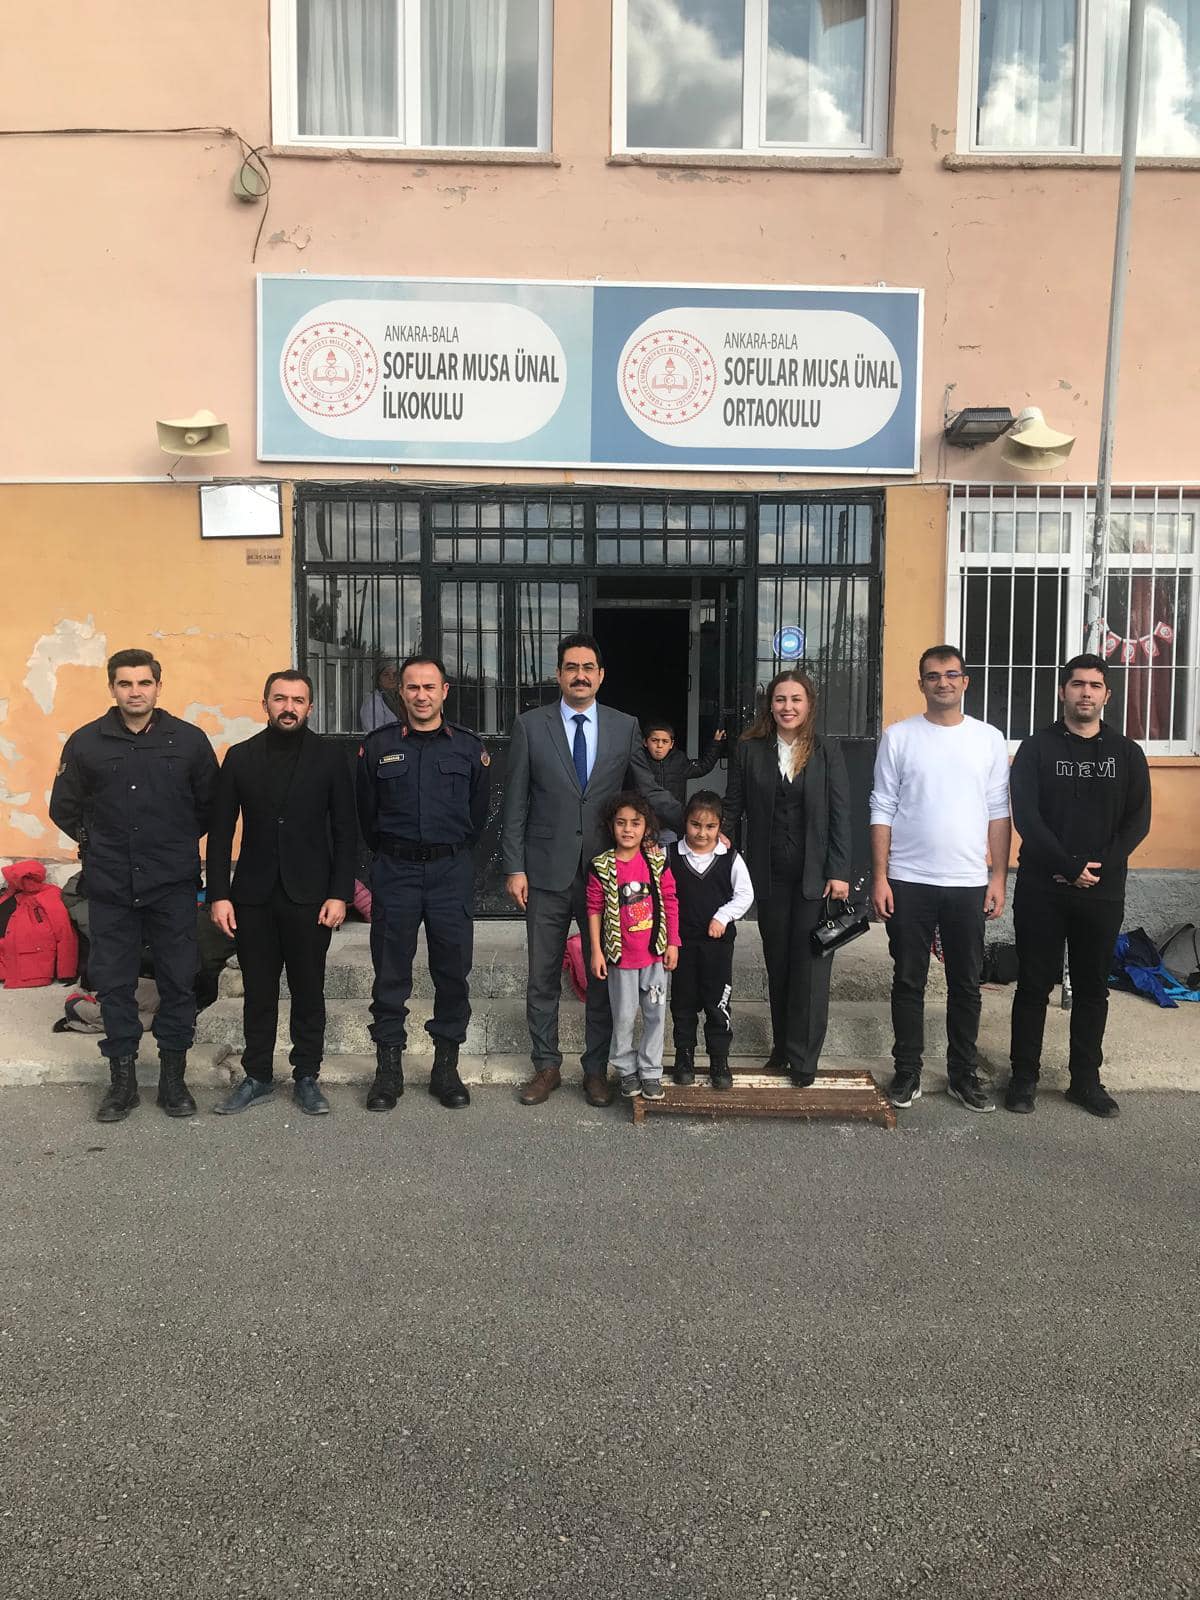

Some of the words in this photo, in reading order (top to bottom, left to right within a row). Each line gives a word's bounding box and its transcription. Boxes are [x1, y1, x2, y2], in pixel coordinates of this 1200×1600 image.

[384, 325, 459, 343] ANKARA-BALA
[723, 332, 798, 350] ANKARA-BALA
[382, 351, 458, 381] SOFULAR
[462, 353, 511, 382] MUSA
[514, 348, 560, 383] ÜNAL
[723, 356, 799, 387] SOFULAR
[802, 358, 850, 388] MUSA
[854, 353, 899, 389] ÜNAL
[383, 384, 464, 421] İLKOKULU
[723, 397, 821, 428] ORTAOKULU
[1056, 757, 1116, 779] mavi
